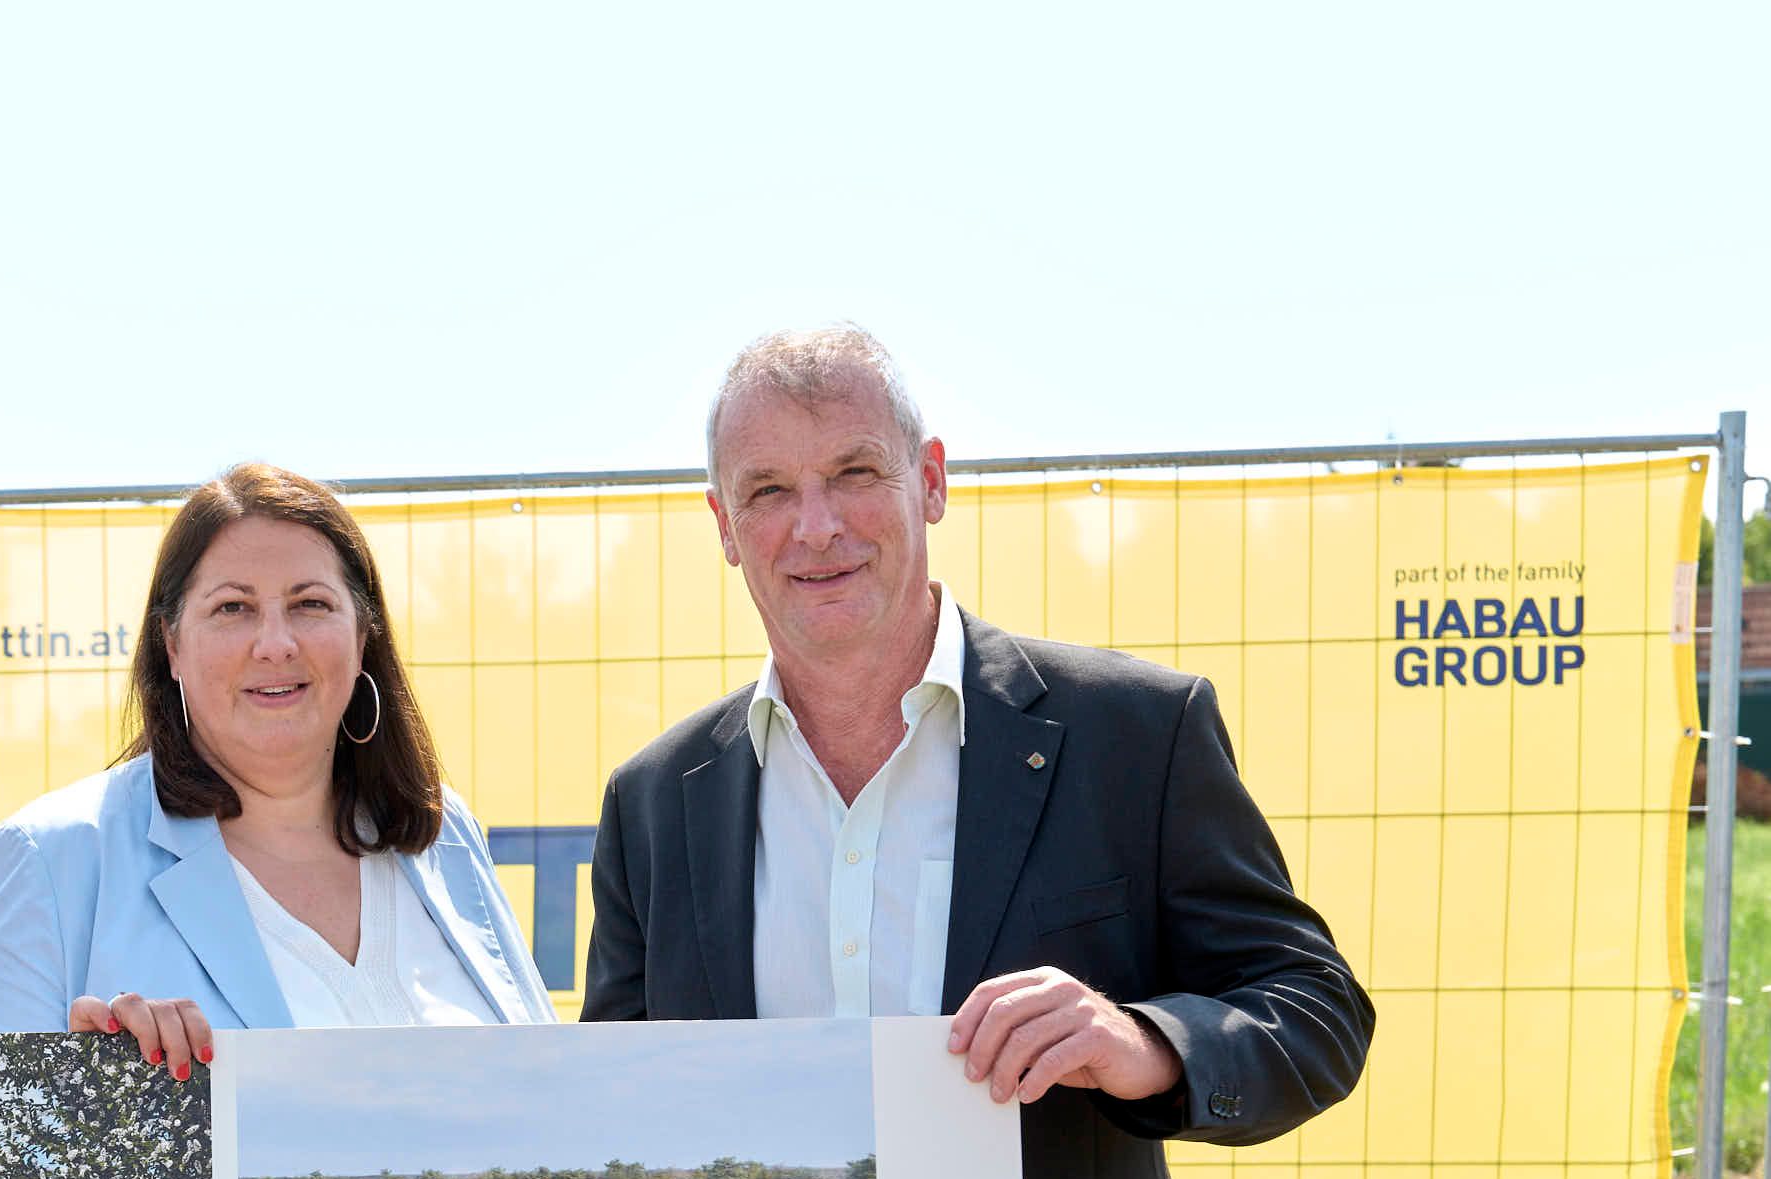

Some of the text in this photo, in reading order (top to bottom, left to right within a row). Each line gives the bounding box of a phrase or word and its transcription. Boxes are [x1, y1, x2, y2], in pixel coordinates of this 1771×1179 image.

[1396, 561, 1586, 586] part of the family
[1395, 595, 1585, 640] HABAU
[1395, 645, 1586, 687] GROUP
